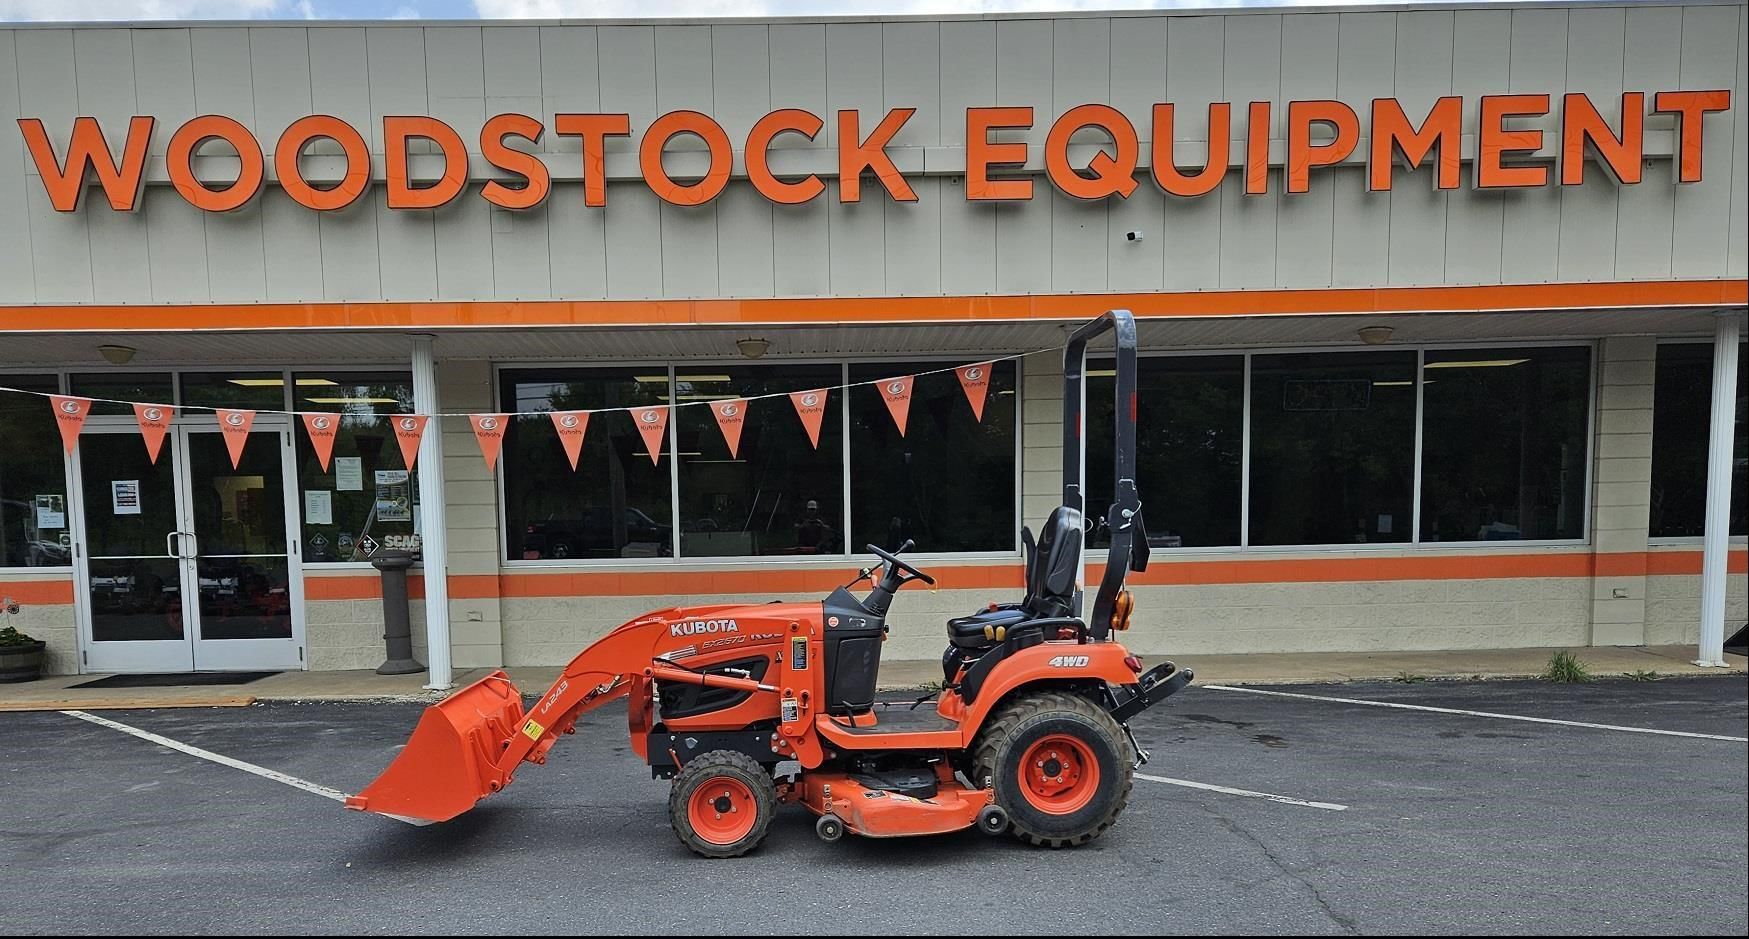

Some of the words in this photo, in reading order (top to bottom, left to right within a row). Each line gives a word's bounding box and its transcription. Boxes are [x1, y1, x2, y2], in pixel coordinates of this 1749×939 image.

[16, 108, 919, 212] WOODSTOCK
[966, 90, 1731, 201] EQUIPMENT
[384, 535, 419, 547] SCAG
[670, 620, 739, 637] KUBOTA
[1048, 655, 1089, 667] 4WD
[541, 680, 568, 714] LA243
